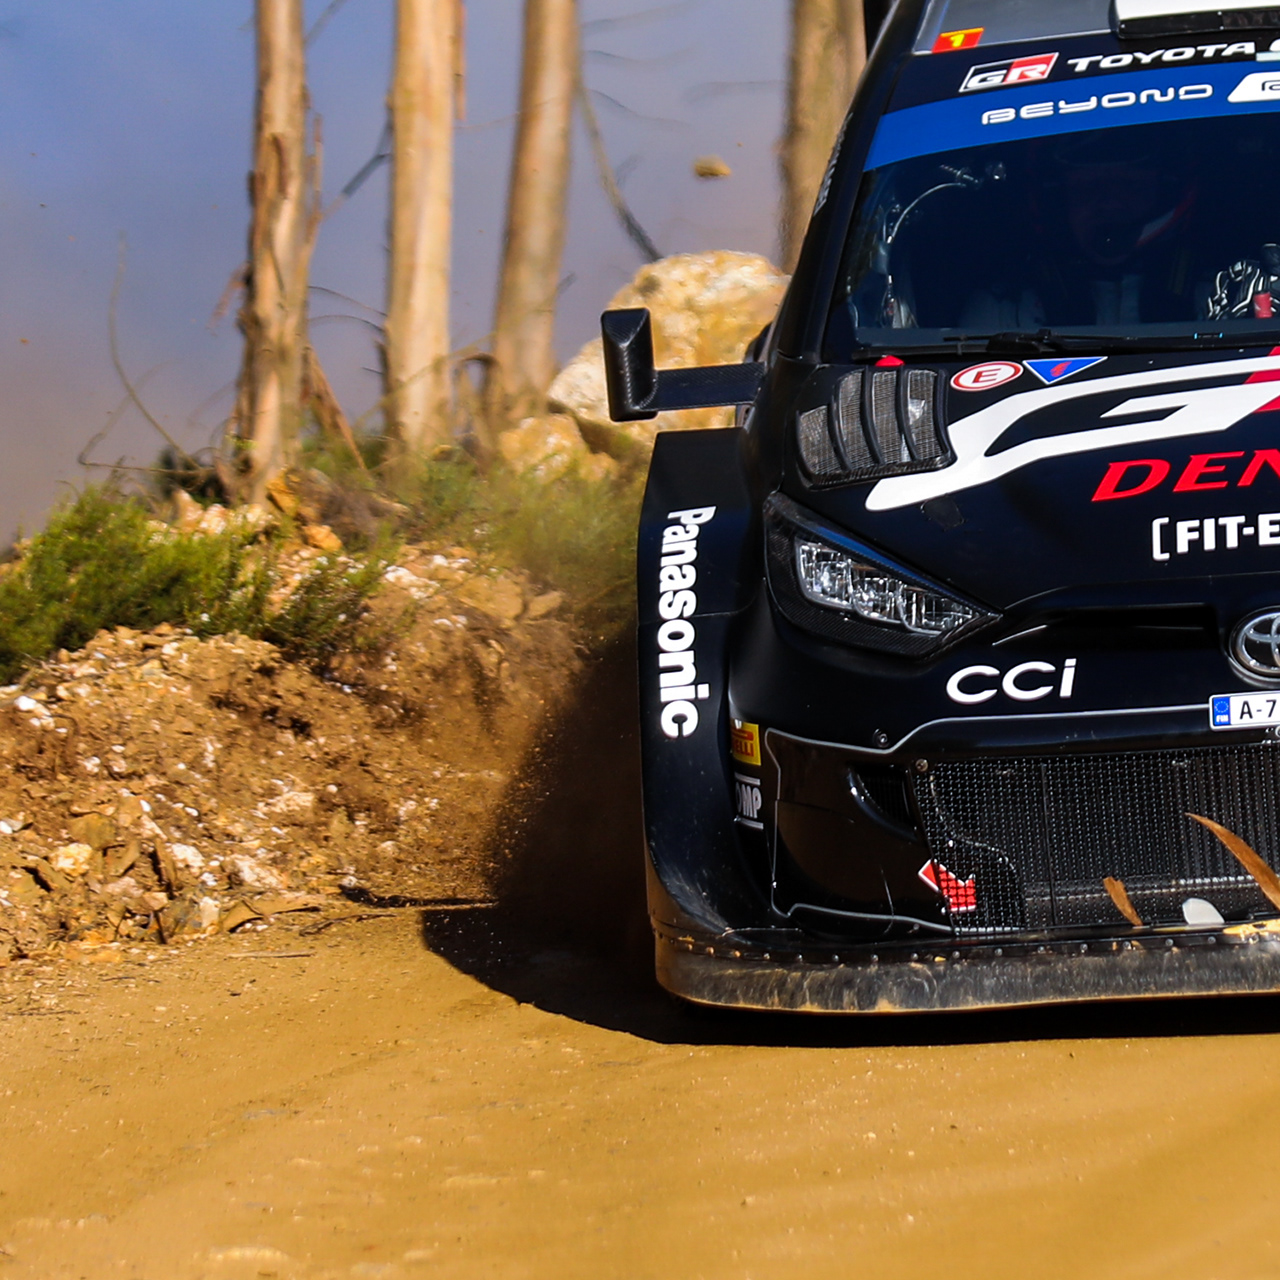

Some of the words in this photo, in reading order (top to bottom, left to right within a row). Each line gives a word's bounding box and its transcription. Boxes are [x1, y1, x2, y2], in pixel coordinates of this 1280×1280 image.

[949, 33, 966, 48] 1
[966, 63, 1048, 89] GR
[1067, 41, 1256, 73] TOYOTA
[981, 83, 1214, 126] BEYOND
[971, 367, 1002, 385] E
[657, 505, 717, 739] Panasonic
[1216, 714, 1229, 723] FIN
